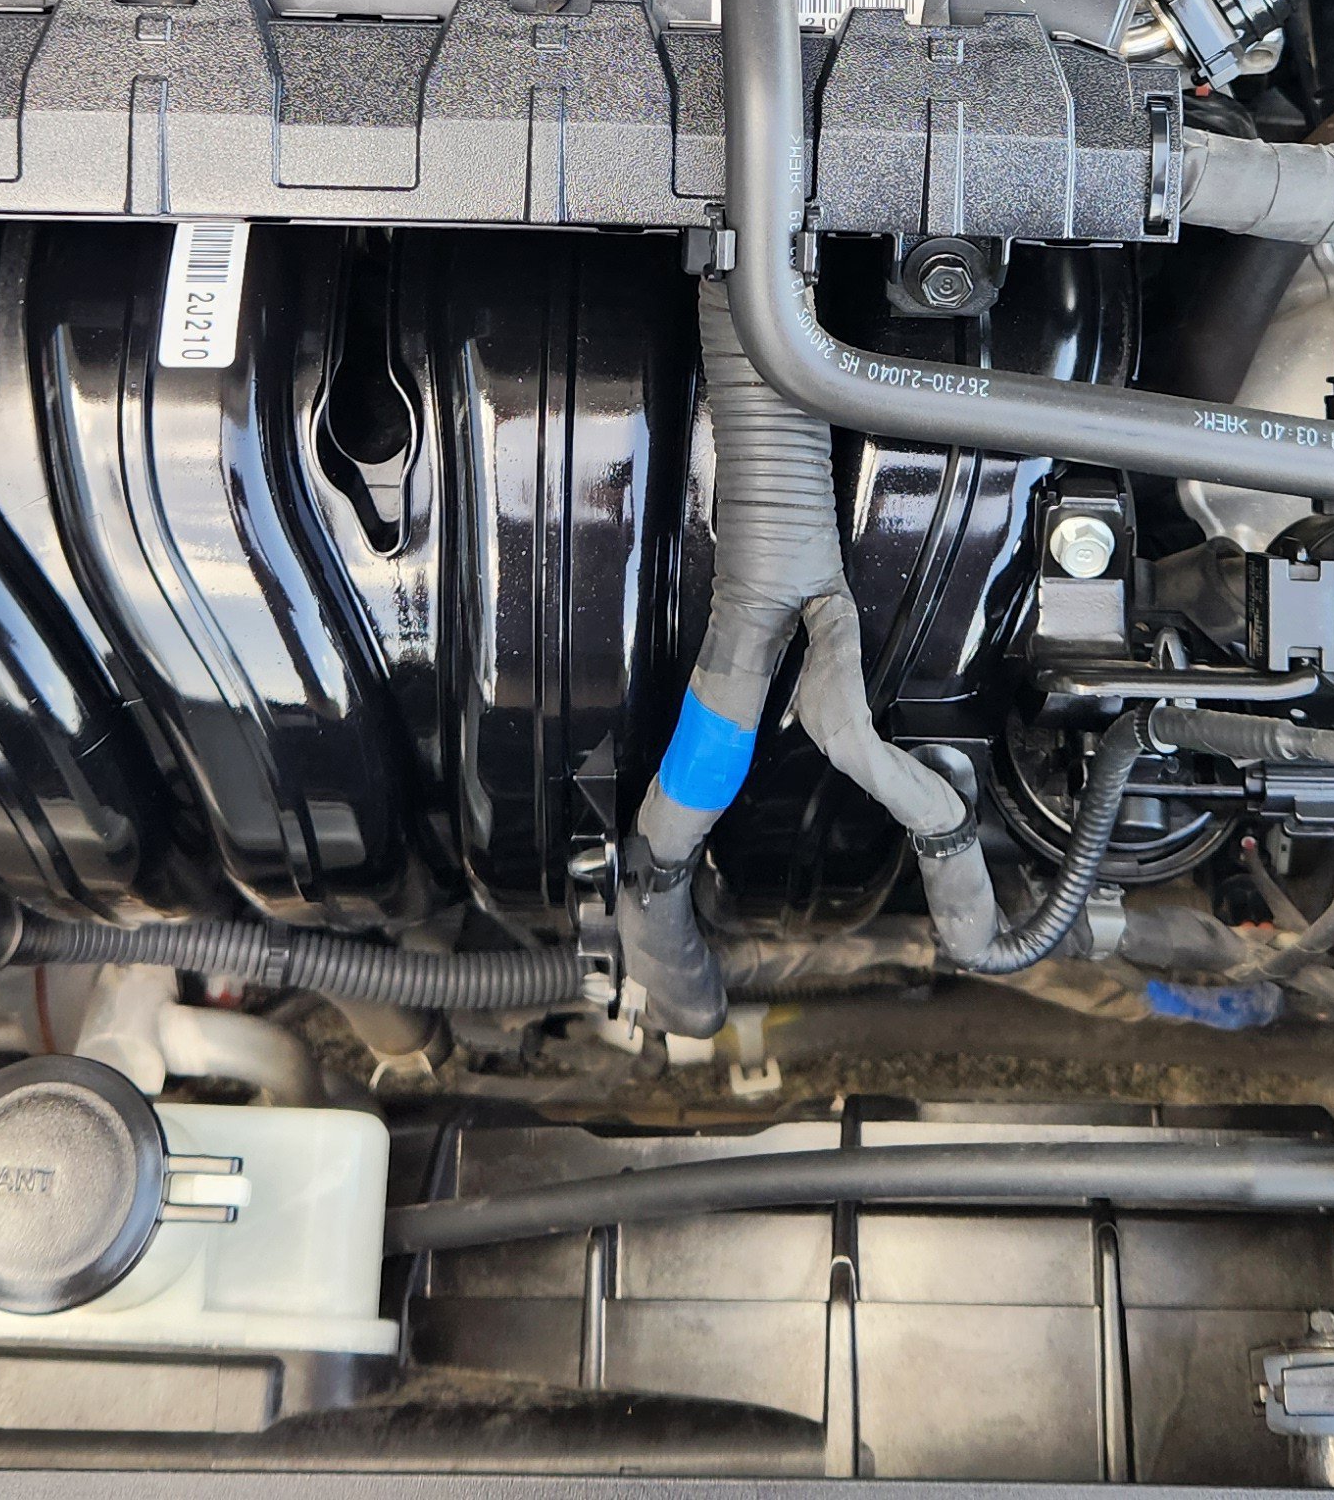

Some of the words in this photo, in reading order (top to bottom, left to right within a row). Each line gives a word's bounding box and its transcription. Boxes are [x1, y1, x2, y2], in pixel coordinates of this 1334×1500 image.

[181, 292, 215, 360] 2J210
[839, 352, 861, 375] HS
[868, 361, 990, 398] 26730-2J040
